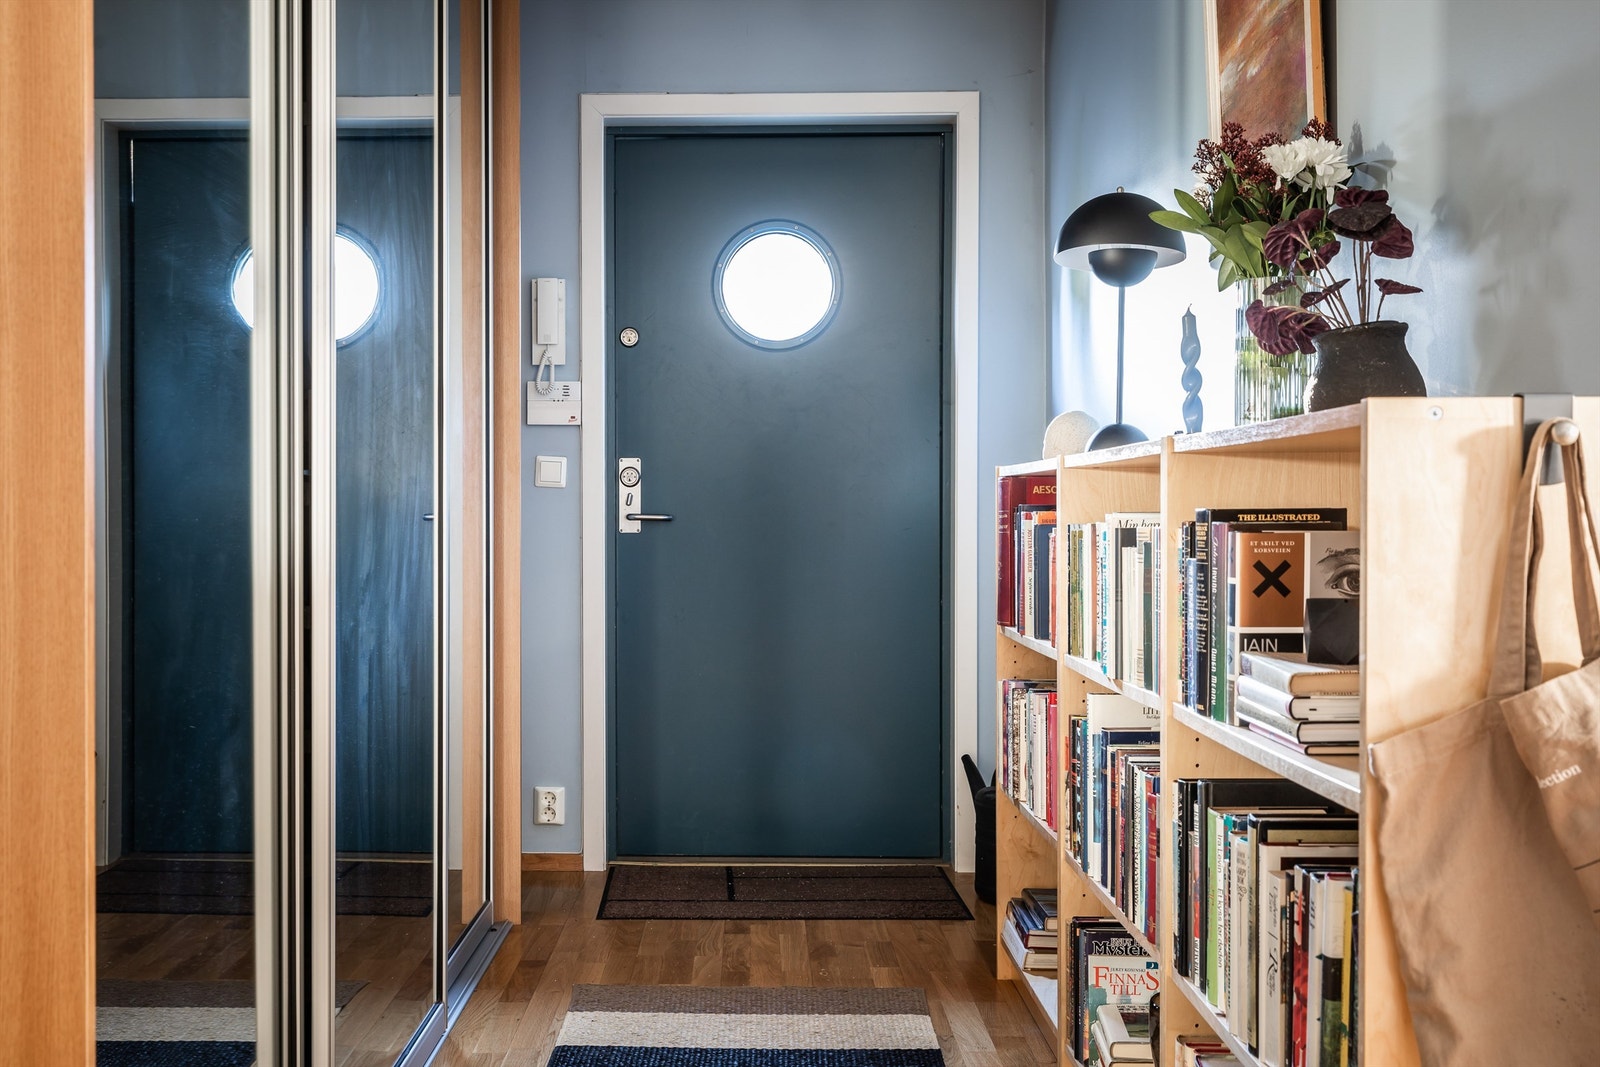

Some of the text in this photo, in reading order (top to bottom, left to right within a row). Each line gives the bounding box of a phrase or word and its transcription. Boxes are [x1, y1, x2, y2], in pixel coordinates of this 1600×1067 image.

[1237, 513, 1321, 521] THE ILLUSTRATED
[1243, 638, 1278, 652] IAIN
[1109, 984, 1142, 996] TILL
